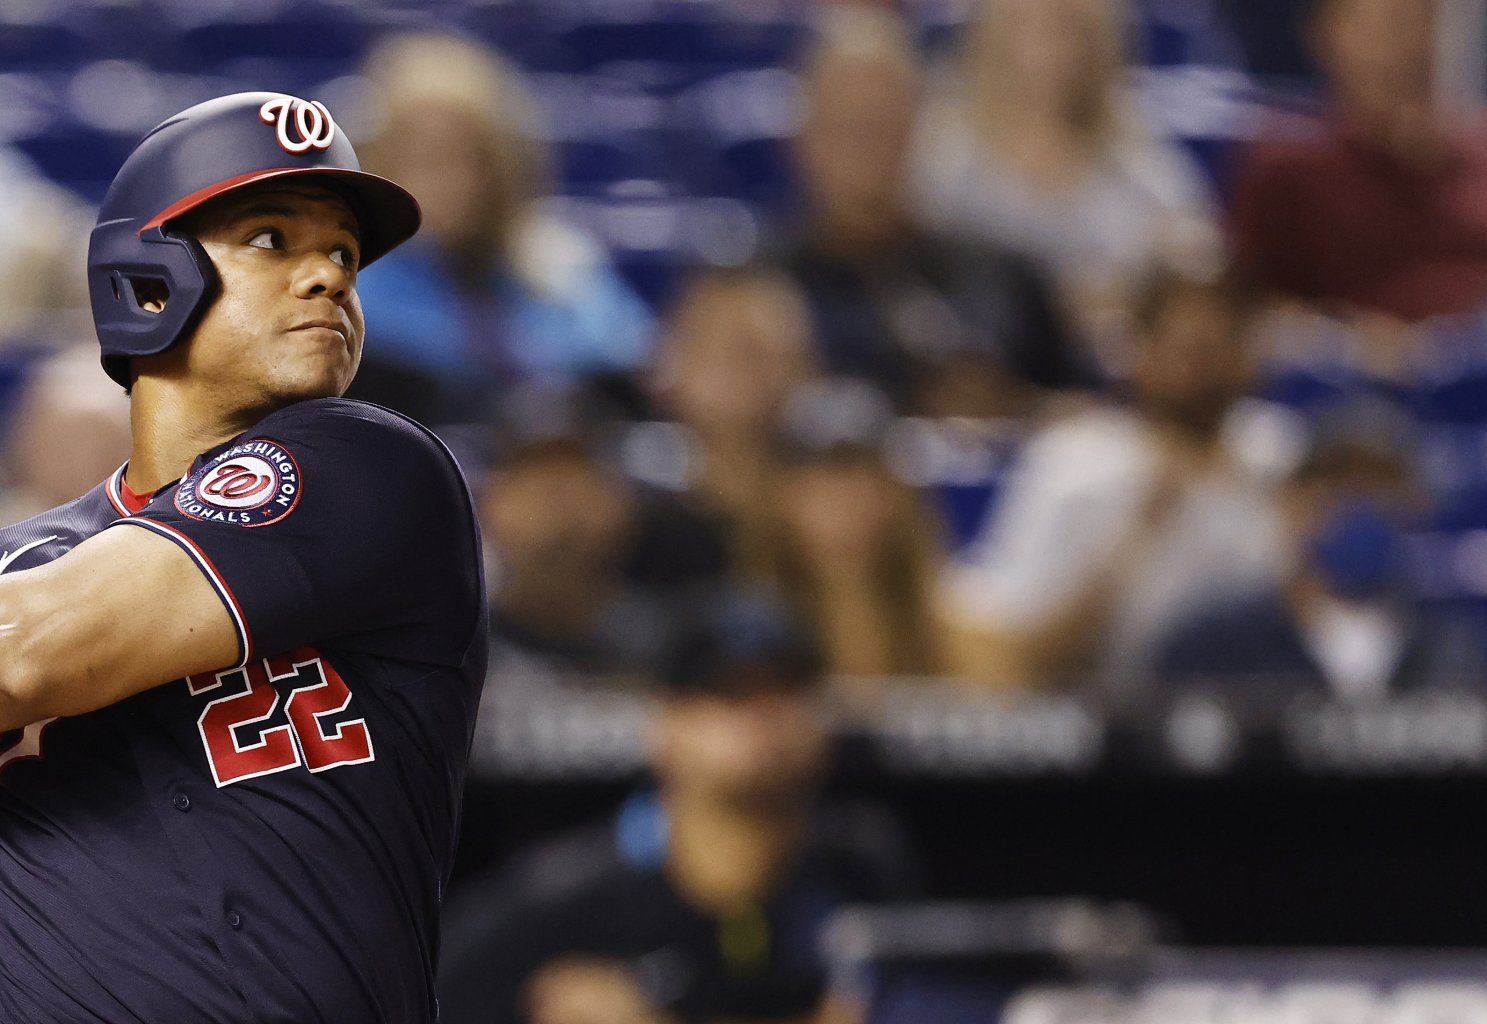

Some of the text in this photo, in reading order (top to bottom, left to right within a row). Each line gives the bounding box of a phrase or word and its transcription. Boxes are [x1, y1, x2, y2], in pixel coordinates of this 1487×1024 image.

[259, 97, 336, 155] W
[177, 481, 251, 523] NATIONALS
[203, 464, 271, 499] W
[214, 441, 296, 507] WASHINGTON
[186, 645, 375, 789] 22
